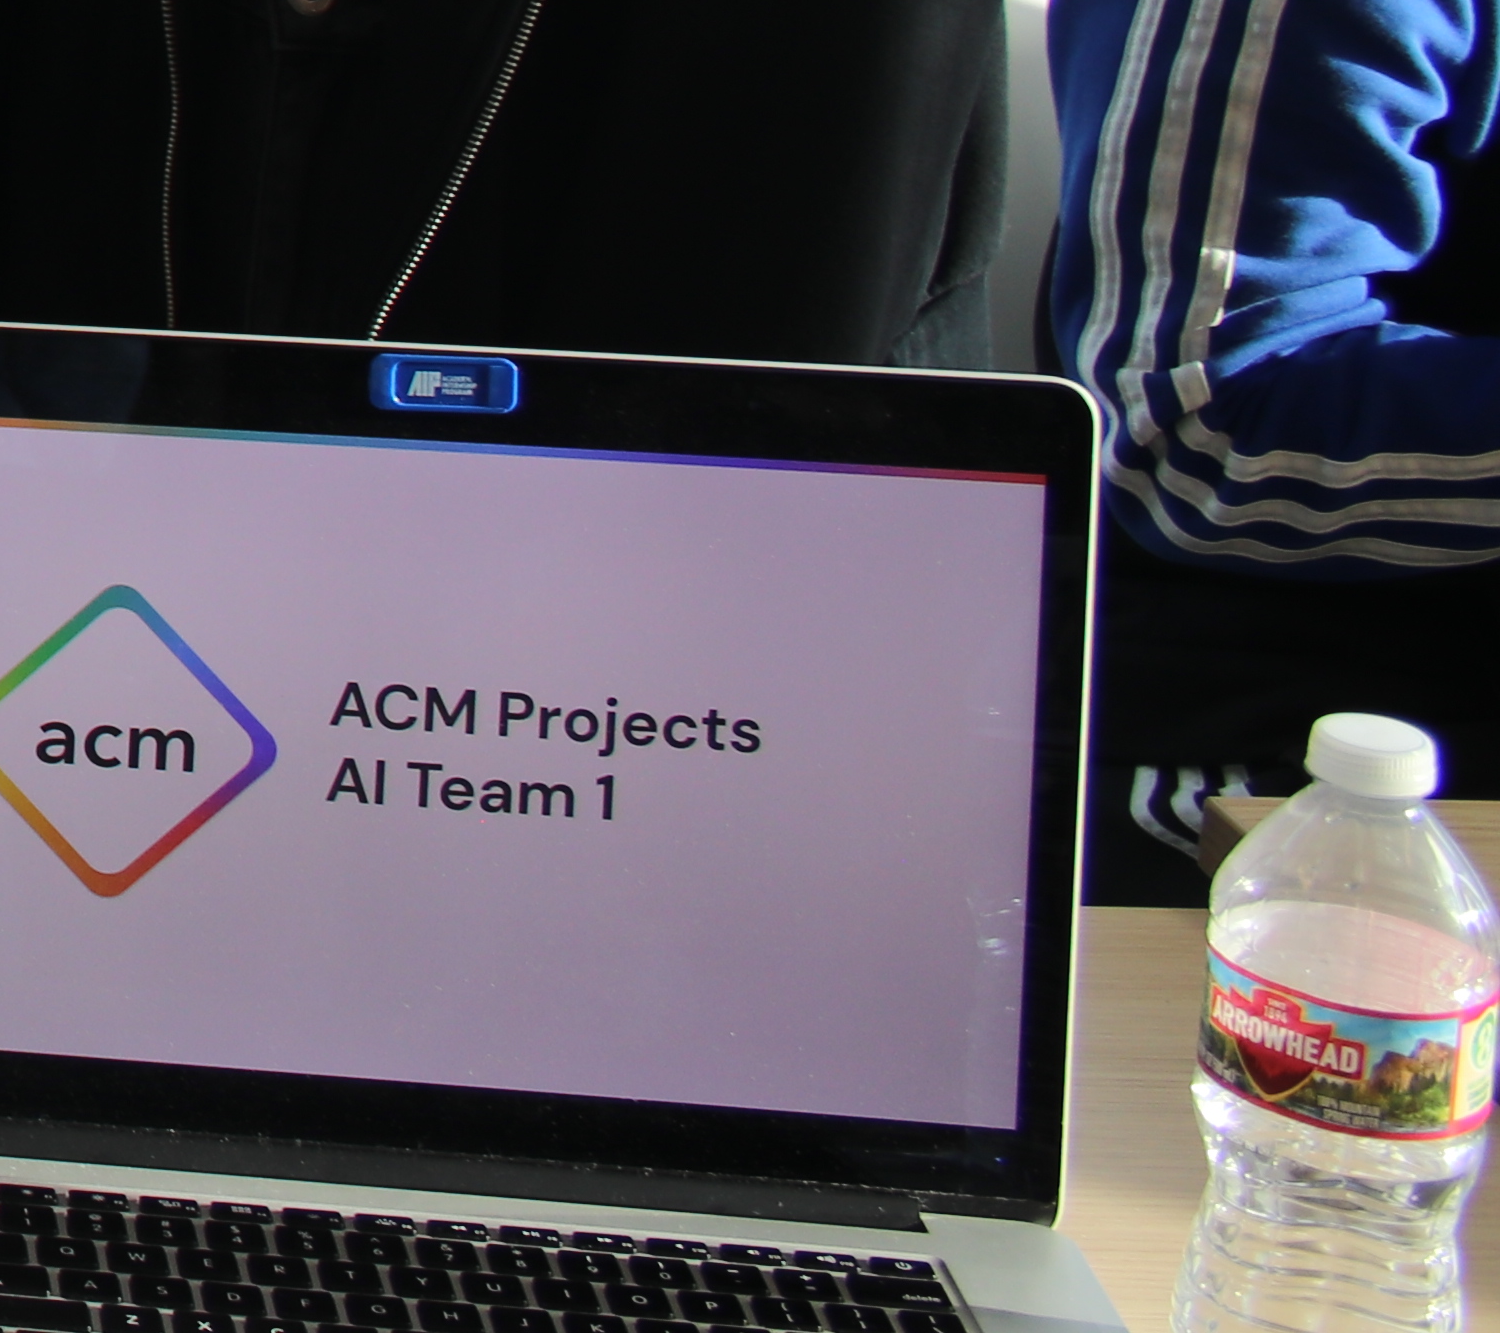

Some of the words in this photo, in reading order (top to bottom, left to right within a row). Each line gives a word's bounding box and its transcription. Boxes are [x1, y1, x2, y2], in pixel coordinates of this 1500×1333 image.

[35, 720, 196, 773] acm
[328, 681, 477, 736] ACM
[498, 691, 763, 758] Projects
[326, 758, 385, 806] AI
[407, 762, 575, 818] Team
[596, 775, 615, 820] 1
[1212, 995, 1360, 1073] ARROWHEAD
